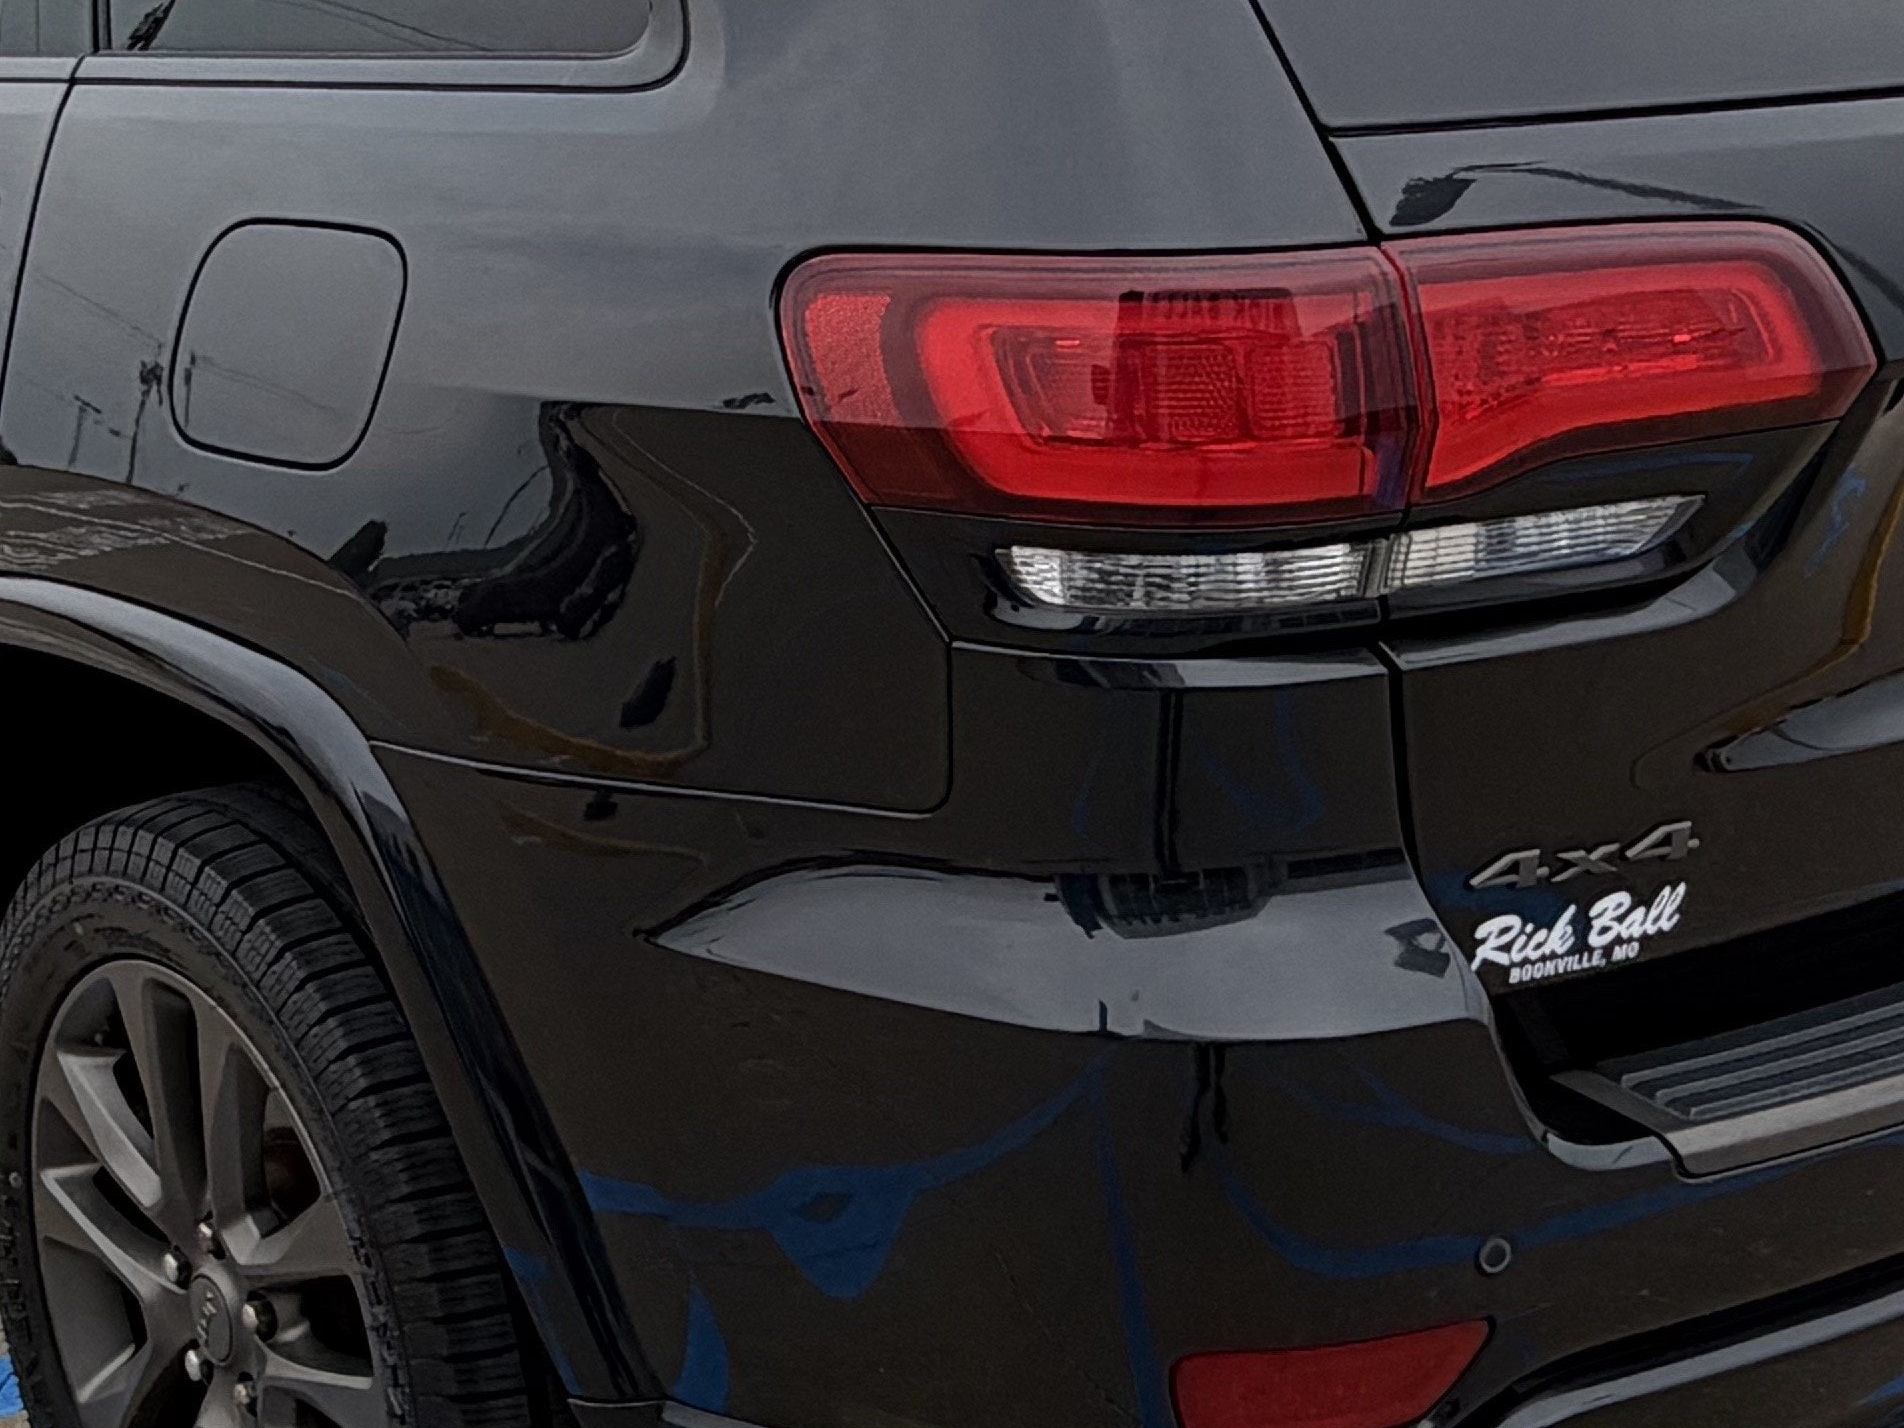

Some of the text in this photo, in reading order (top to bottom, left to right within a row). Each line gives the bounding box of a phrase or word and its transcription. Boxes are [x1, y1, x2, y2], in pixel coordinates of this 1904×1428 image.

[1470, 881, 1687, 972] Rick Ball
[1508, 941, 1640, 984] BOONVILLE, MO
